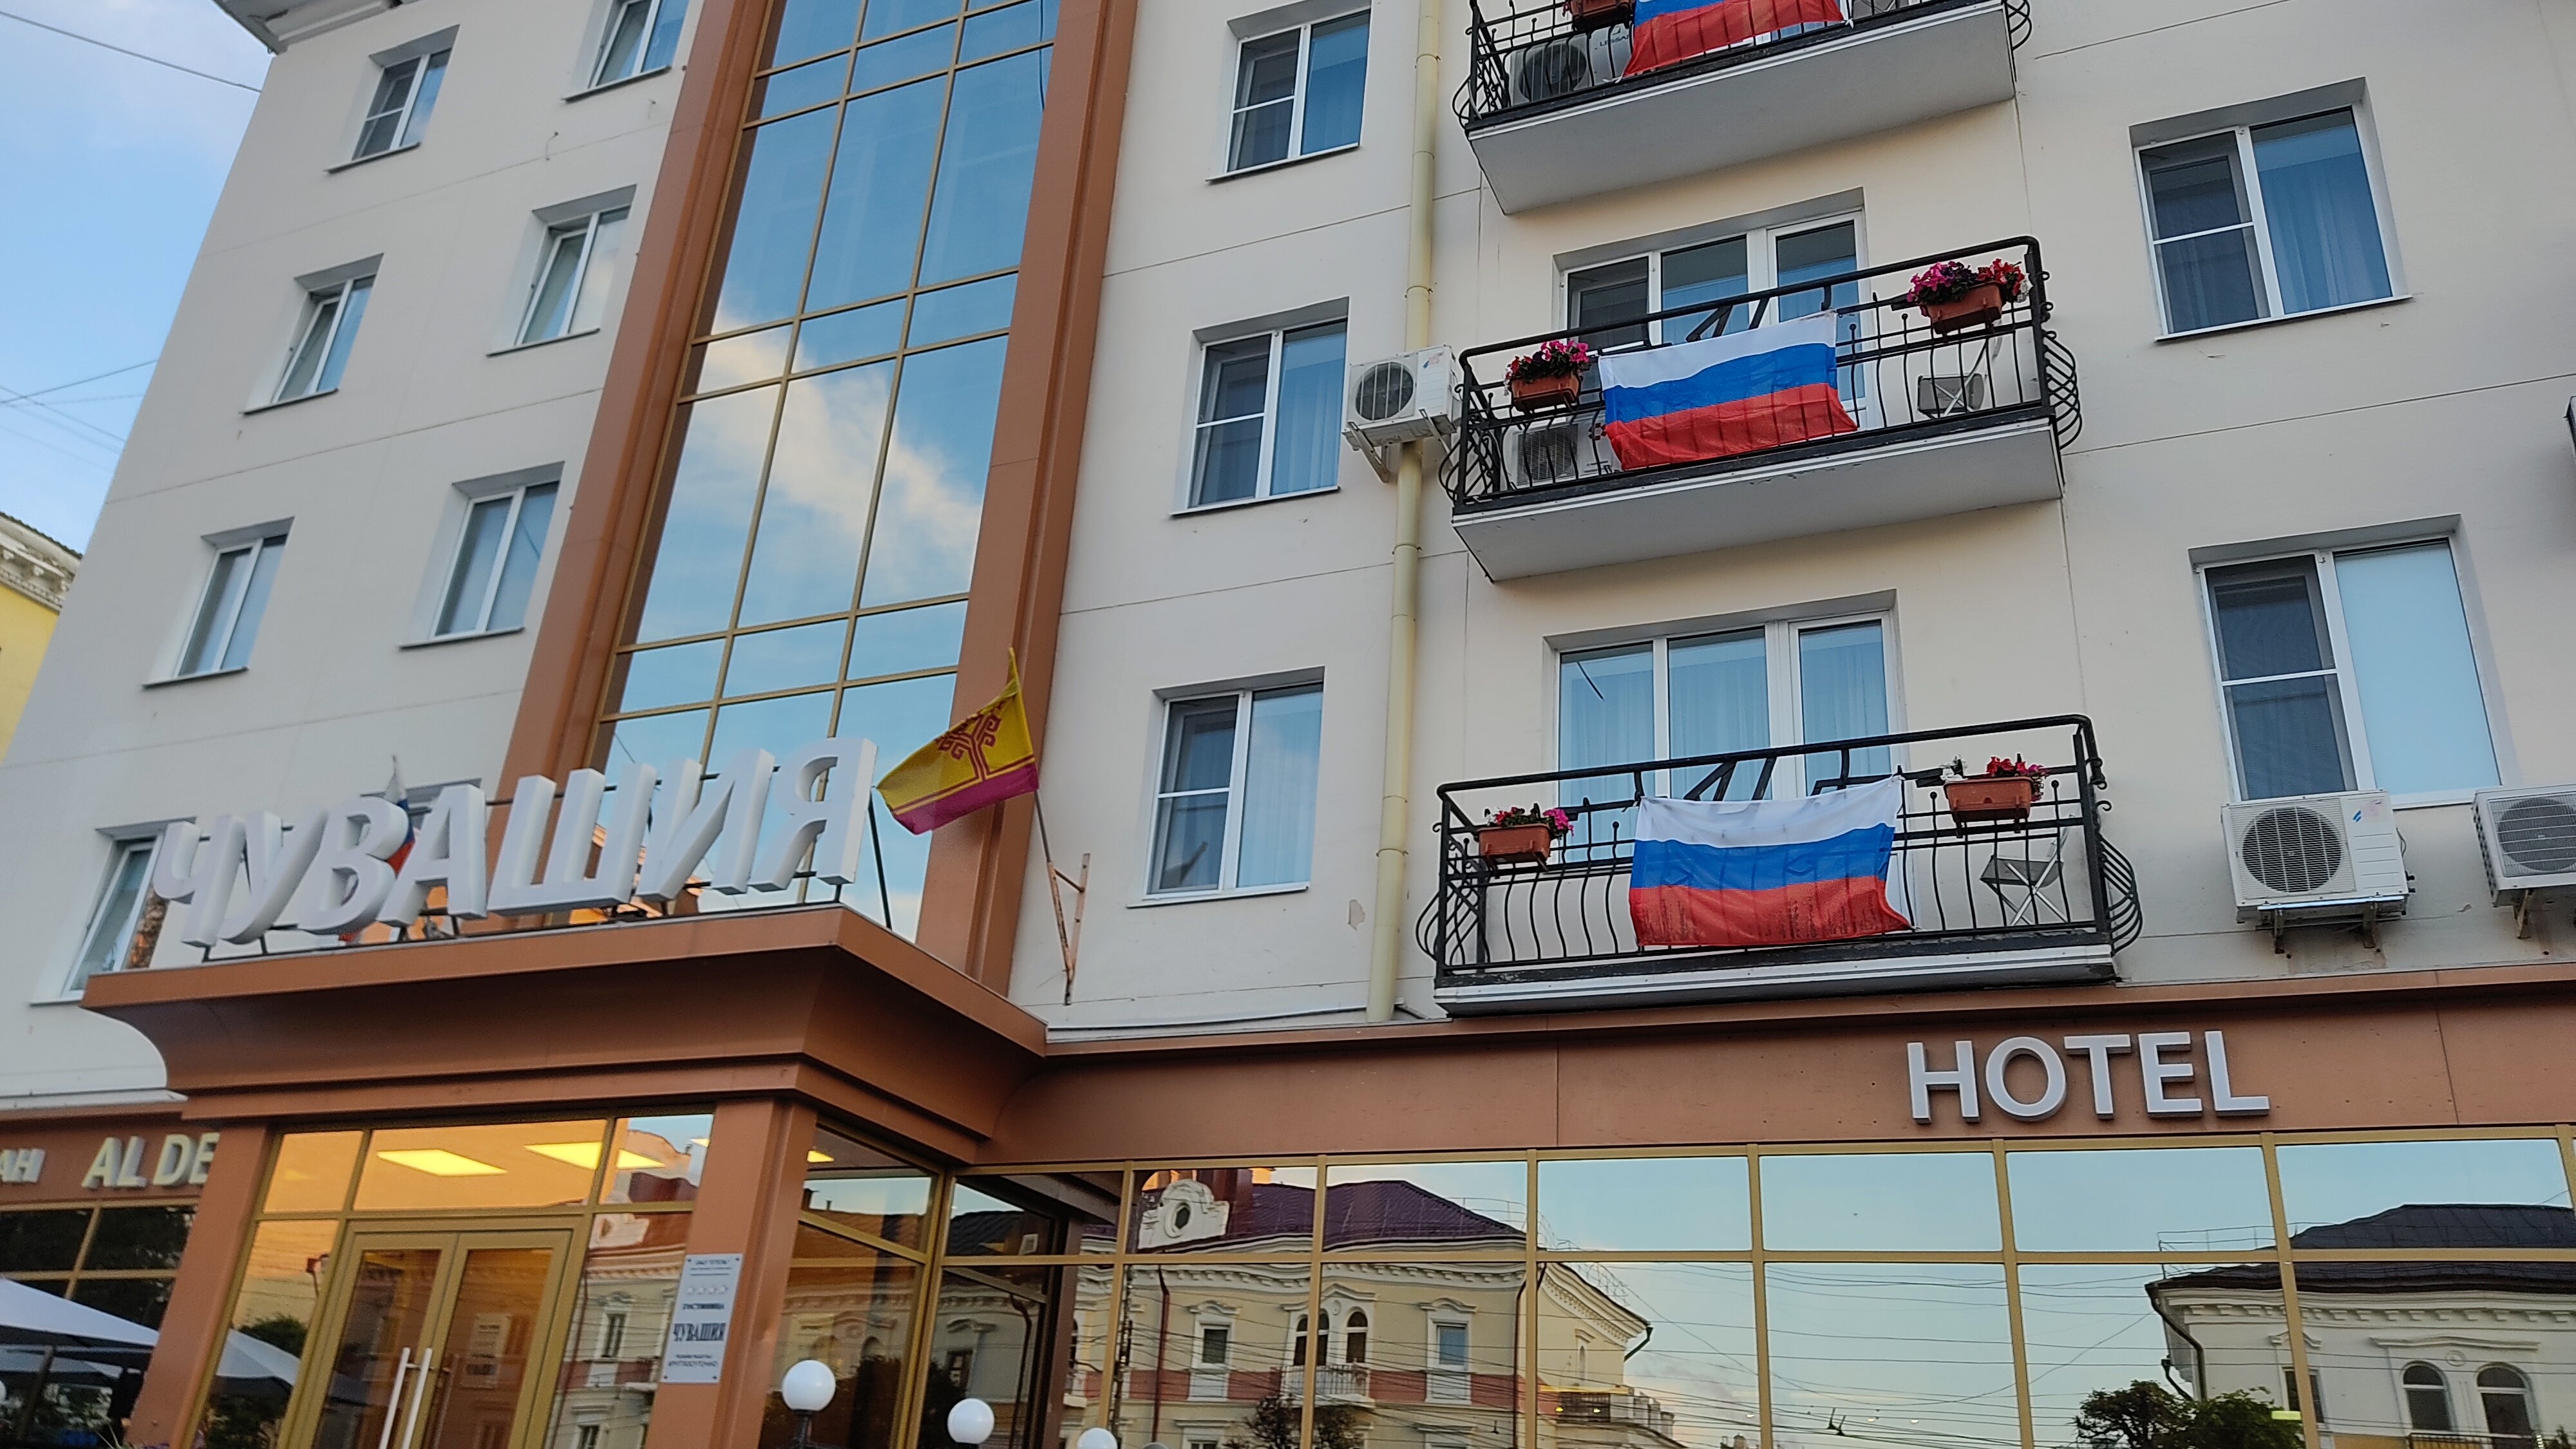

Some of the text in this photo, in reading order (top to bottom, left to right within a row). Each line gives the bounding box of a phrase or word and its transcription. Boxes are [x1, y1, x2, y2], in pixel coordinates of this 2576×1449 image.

[153, 738, 878, 947] ЧУВАШИЯ
[1907, 1030, 2270, 1124] HOTEL
[81, 1136, 147, 1188] AL
[673, 1323, 726, 1341] ЧУВАШИЯ
